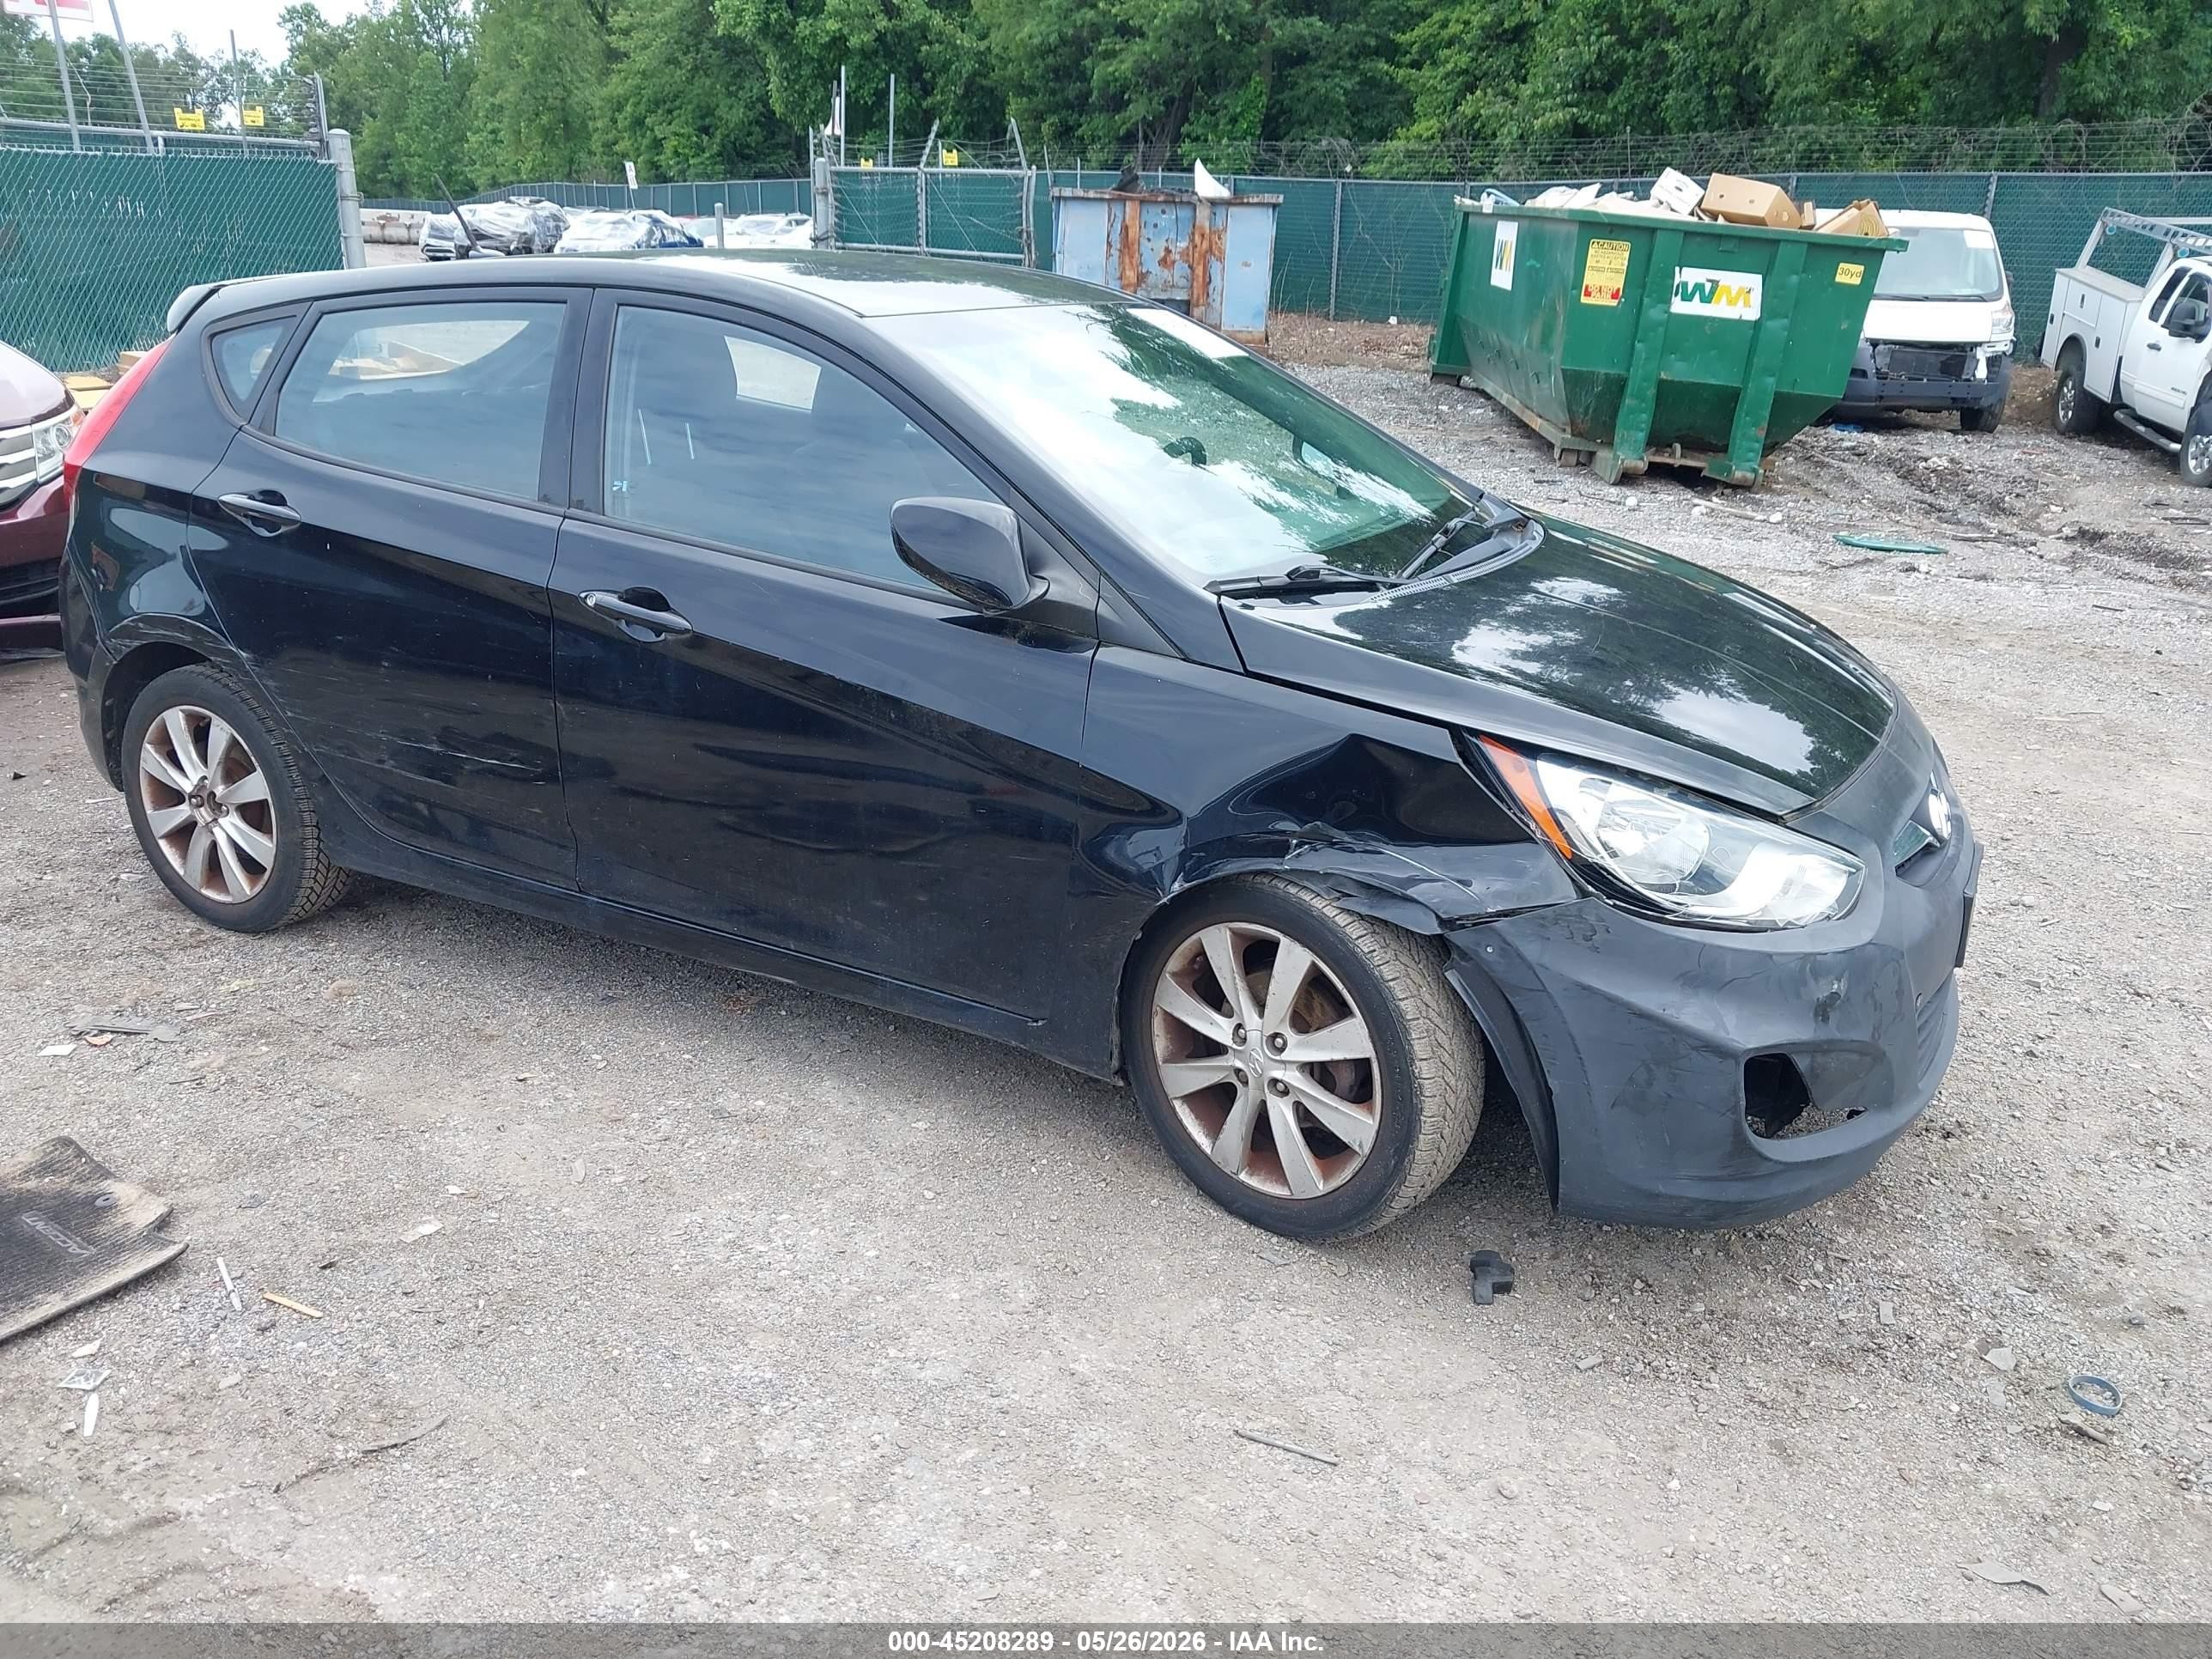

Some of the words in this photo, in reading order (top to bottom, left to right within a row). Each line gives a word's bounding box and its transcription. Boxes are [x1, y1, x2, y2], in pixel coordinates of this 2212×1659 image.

[1598, 241, 1629, 251] CAUTION
[1838, 267, 1863, 279] 30yd
[1680, 279, 1752, 308] WM
